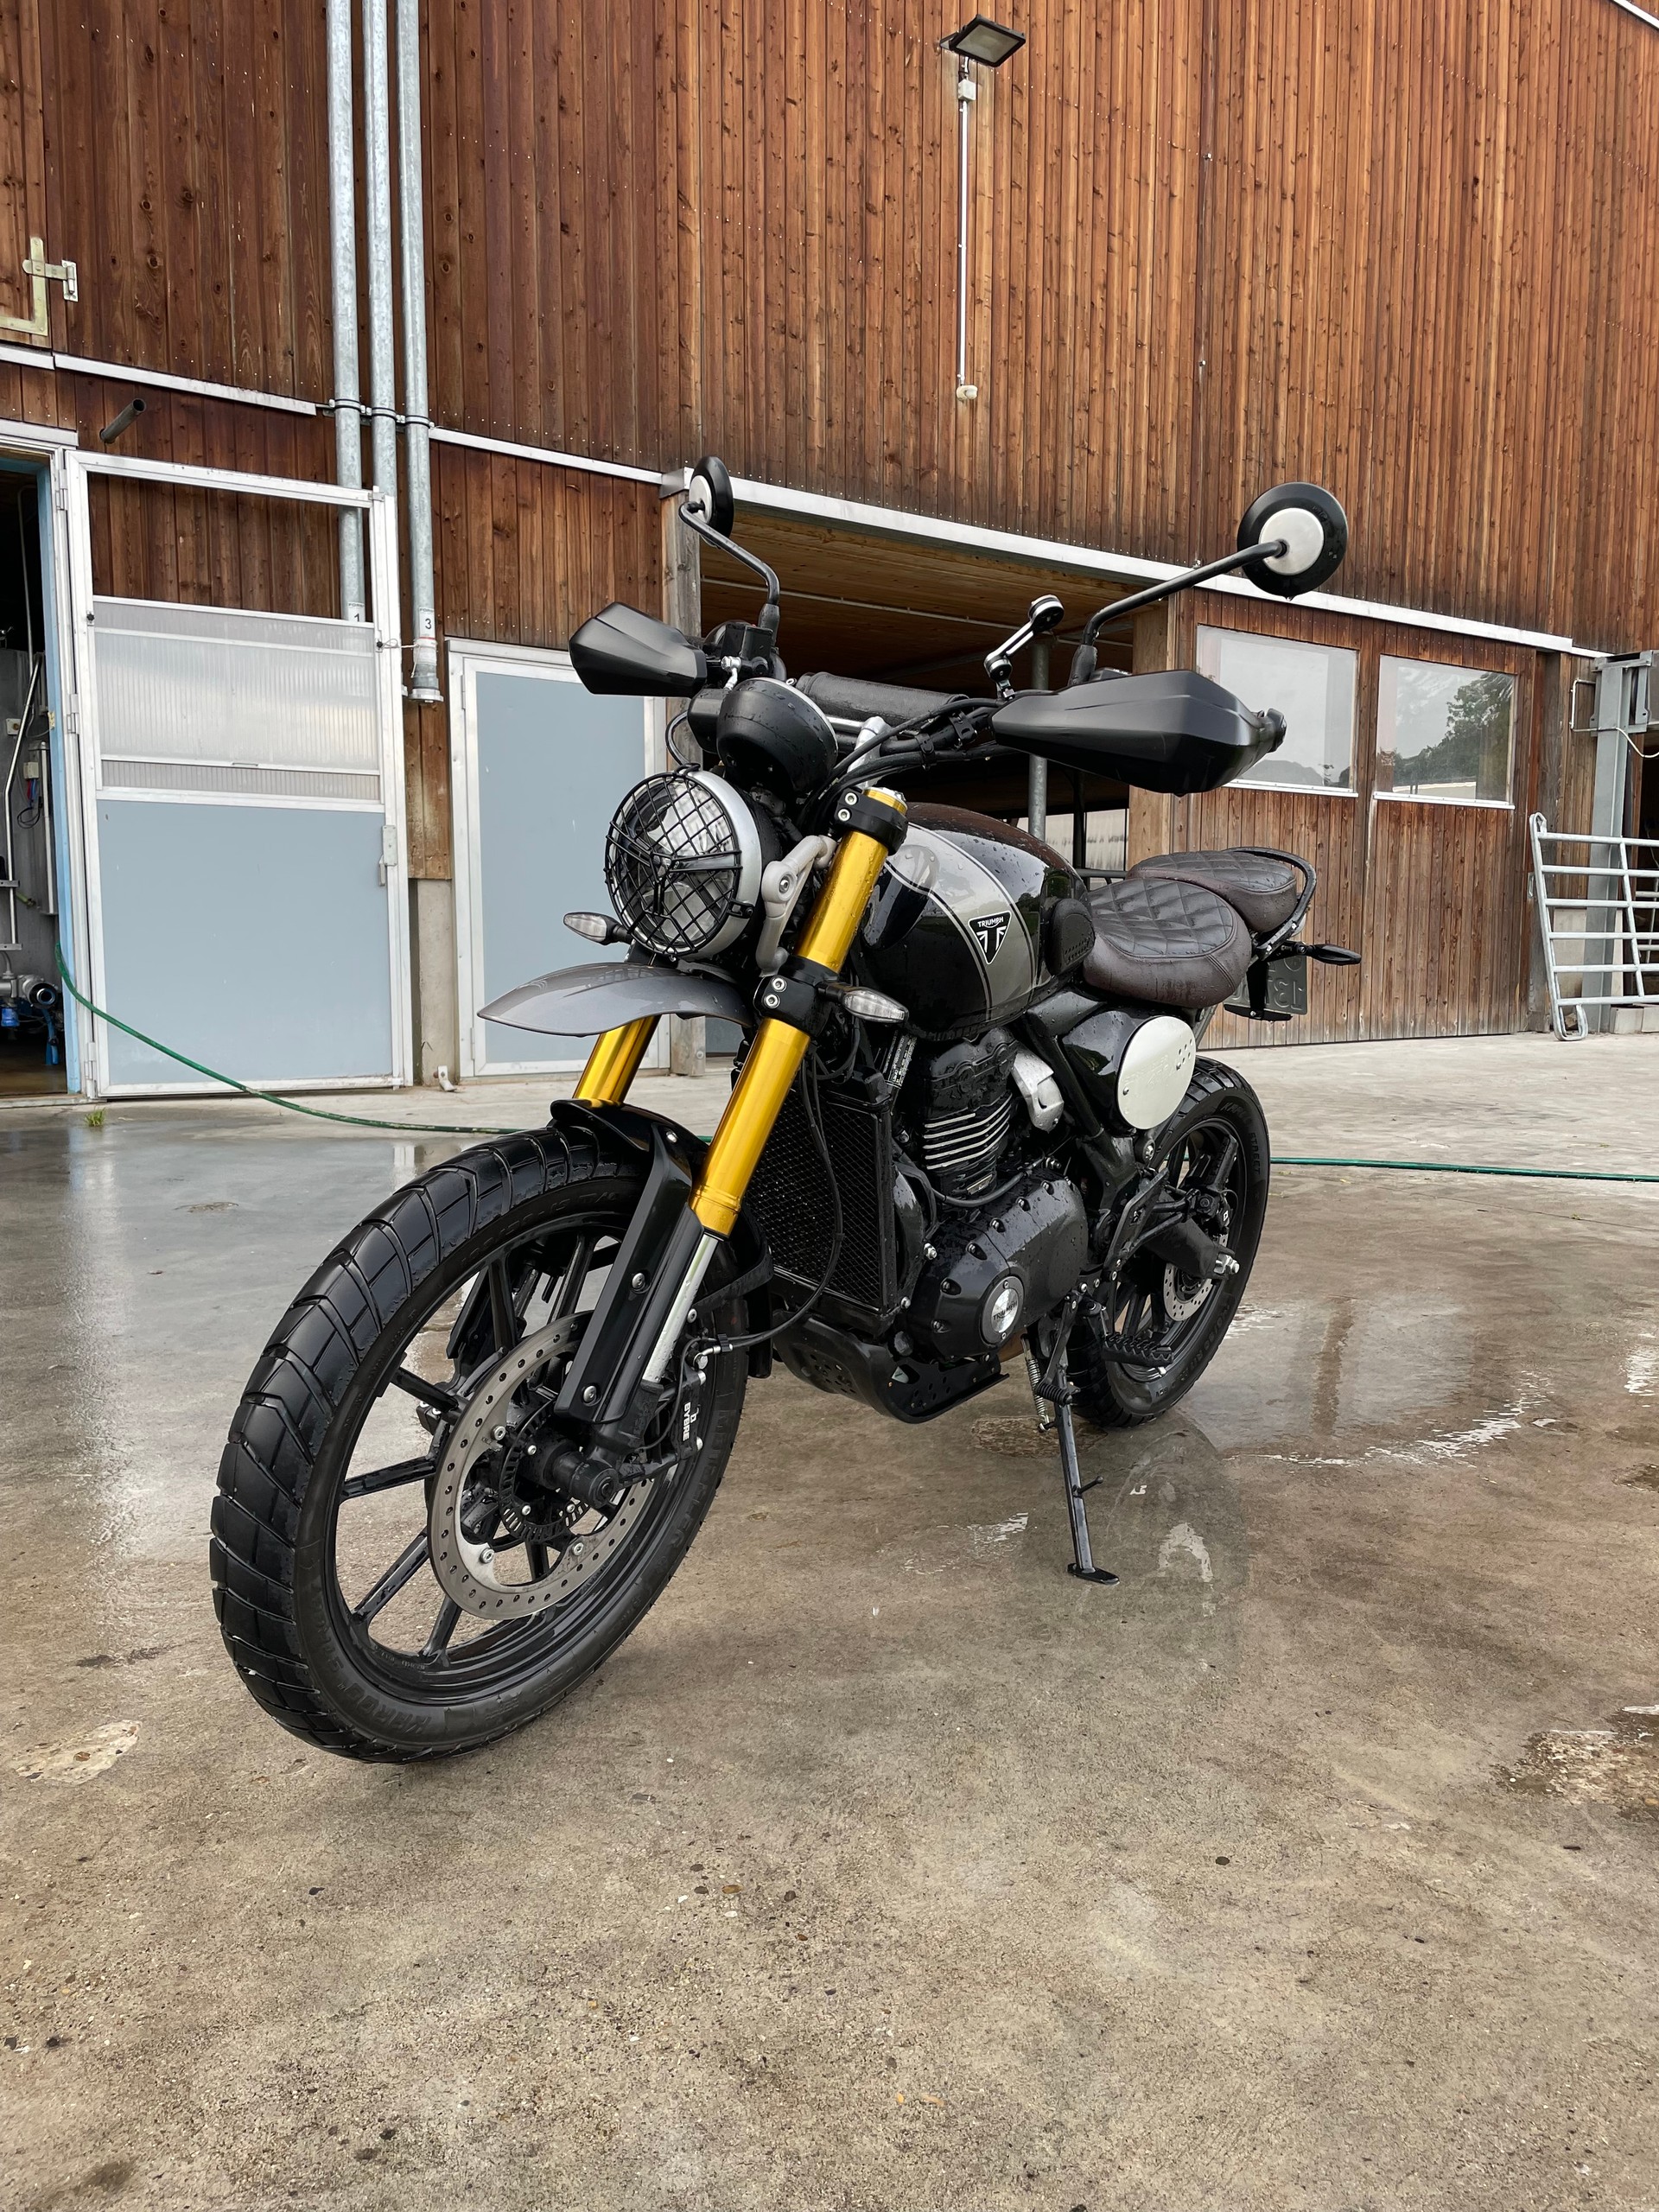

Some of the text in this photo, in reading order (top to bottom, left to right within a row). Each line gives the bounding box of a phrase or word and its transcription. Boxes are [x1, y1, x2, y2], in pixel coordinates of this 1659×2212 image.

[425, 618, 432, 630] 3
[977, 916, 1004, 928] TRIUMPH
[1249, 1132, 1262, 1176] STREET
[993, 1301, 1017, 1320] TRIUMPH
[683, 1402, 691, 1441] BYBRE
